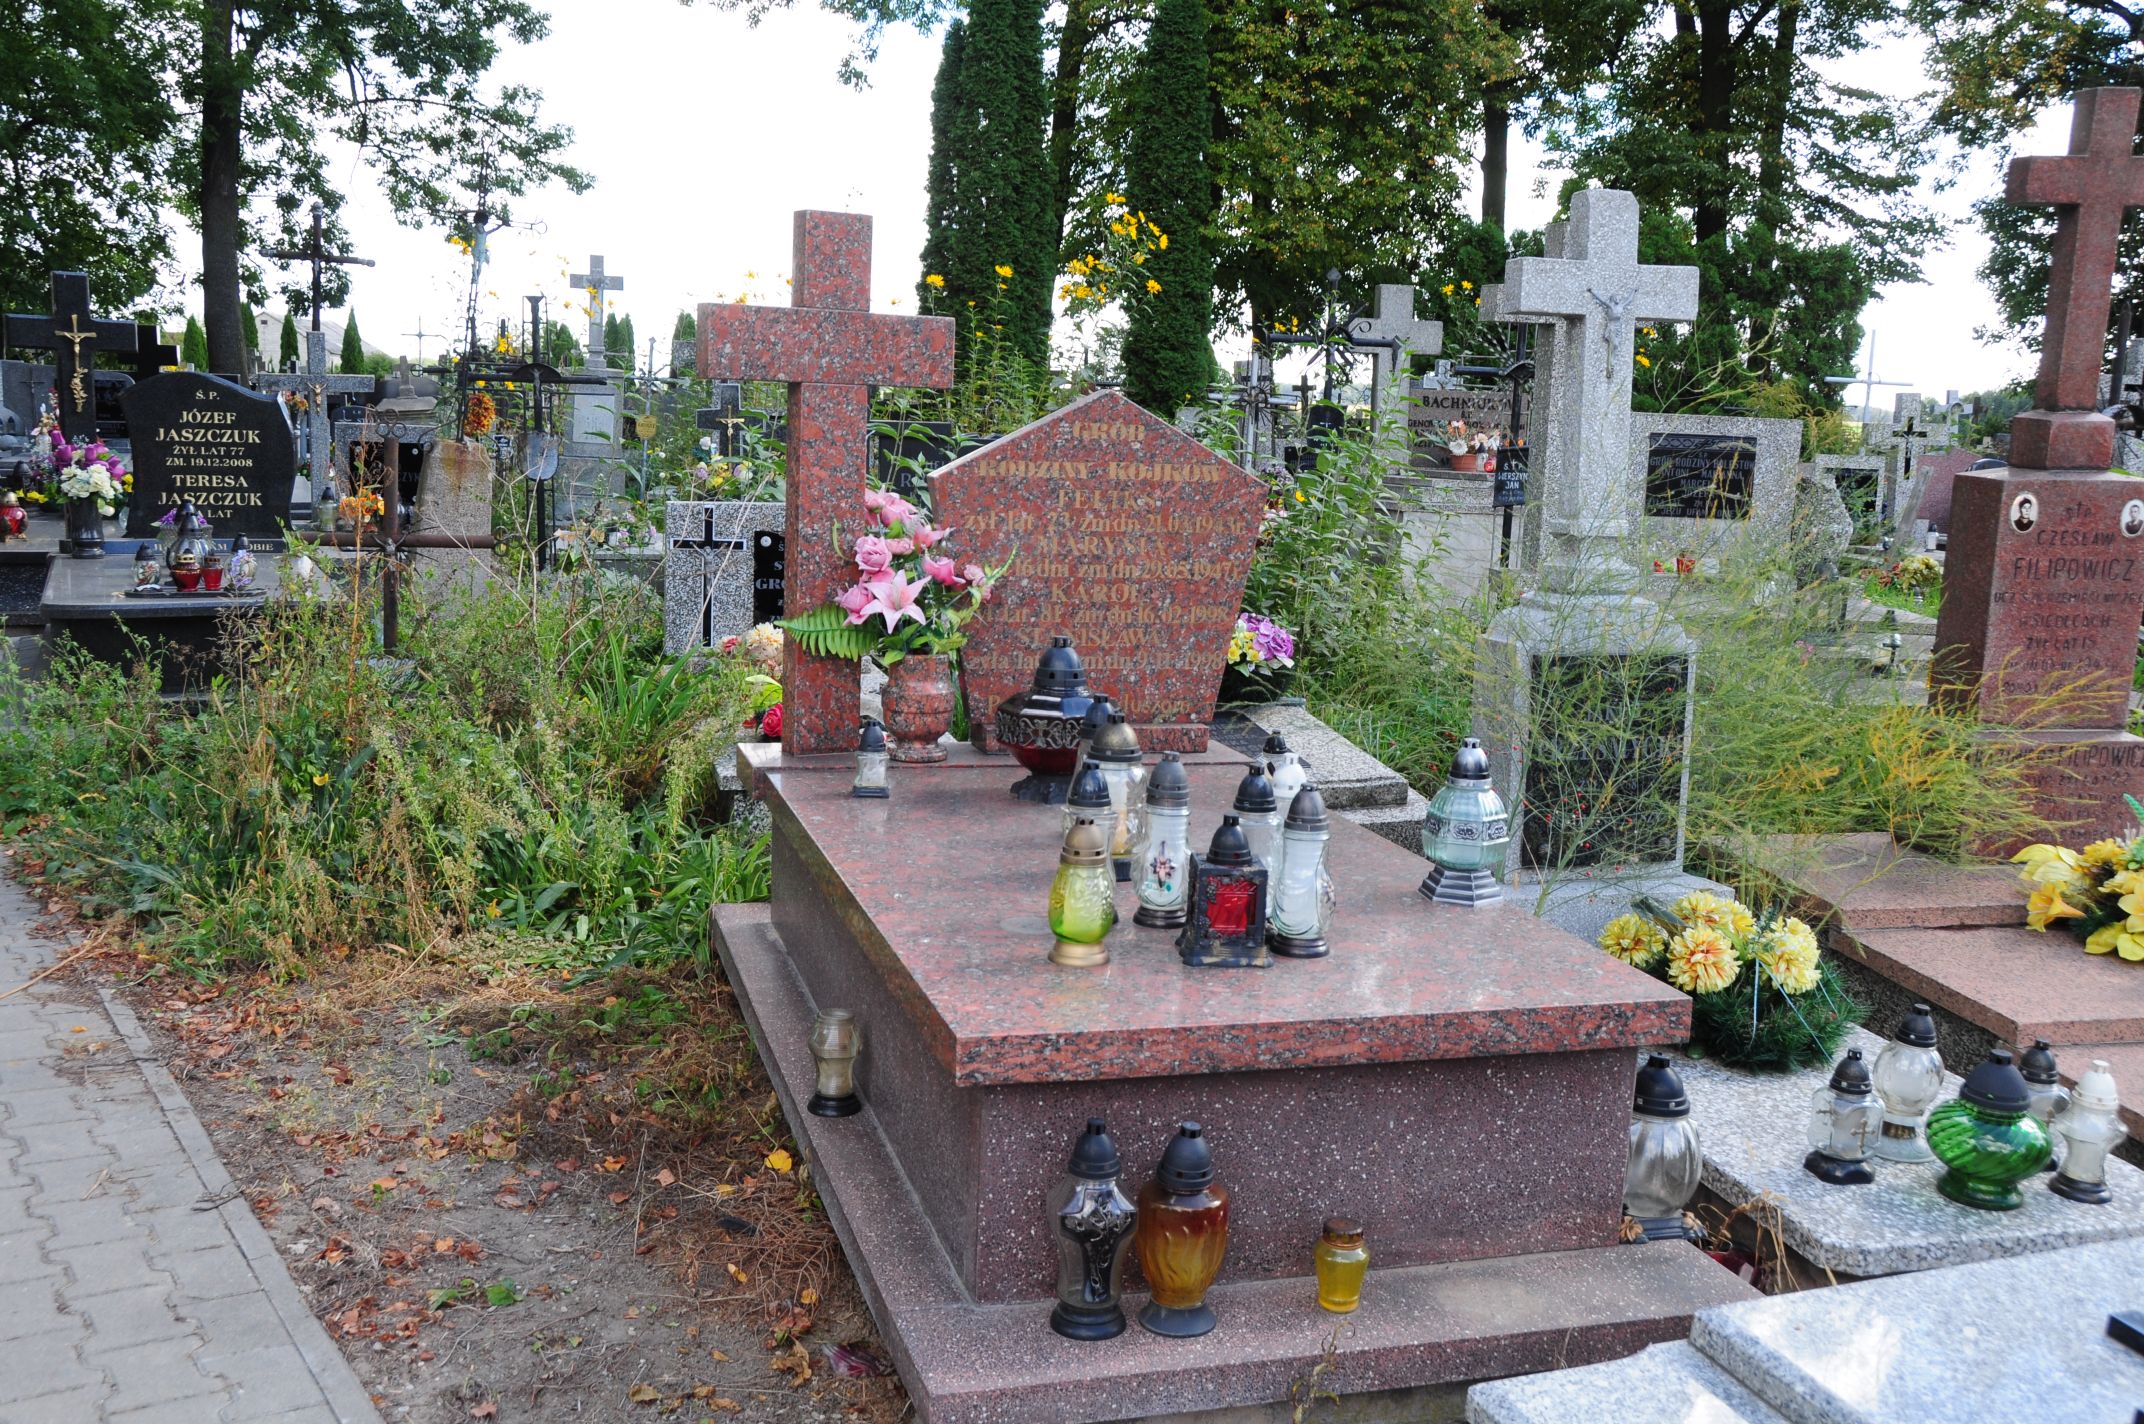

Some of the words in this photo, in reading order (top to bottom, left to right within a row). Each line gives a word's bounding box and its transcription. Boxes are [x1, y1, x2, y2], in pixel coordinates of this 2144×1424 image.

[179, 408, 237, 424] JÓZEF
[155, 428, 261, 444] JASZCZUK
[172, 445, 198, 456] ŻYŁ
[201, 446, 227, 456] LAT
[230, 447, 245, 456] 77
[165, 457, 187, 466] ZM.
[190, 457, 253, 467] 19.12.2008
[979, 459, 1093, 480] RODZINY
[171, 474, 249, 488] TERESA
[1504, 481, 1520, 490] JAN
[158, 491, 263, 507] JASZCZUK
[1058, 489, 1157, 510] FELIKS
[207, 509, 234, 518] LAT
[2037, 529, 2115, 546] CZESŁAW
[2013, 557, 2135, 581] FILIPOWICZ
[1051, 583, 1141, 602] KAROL
